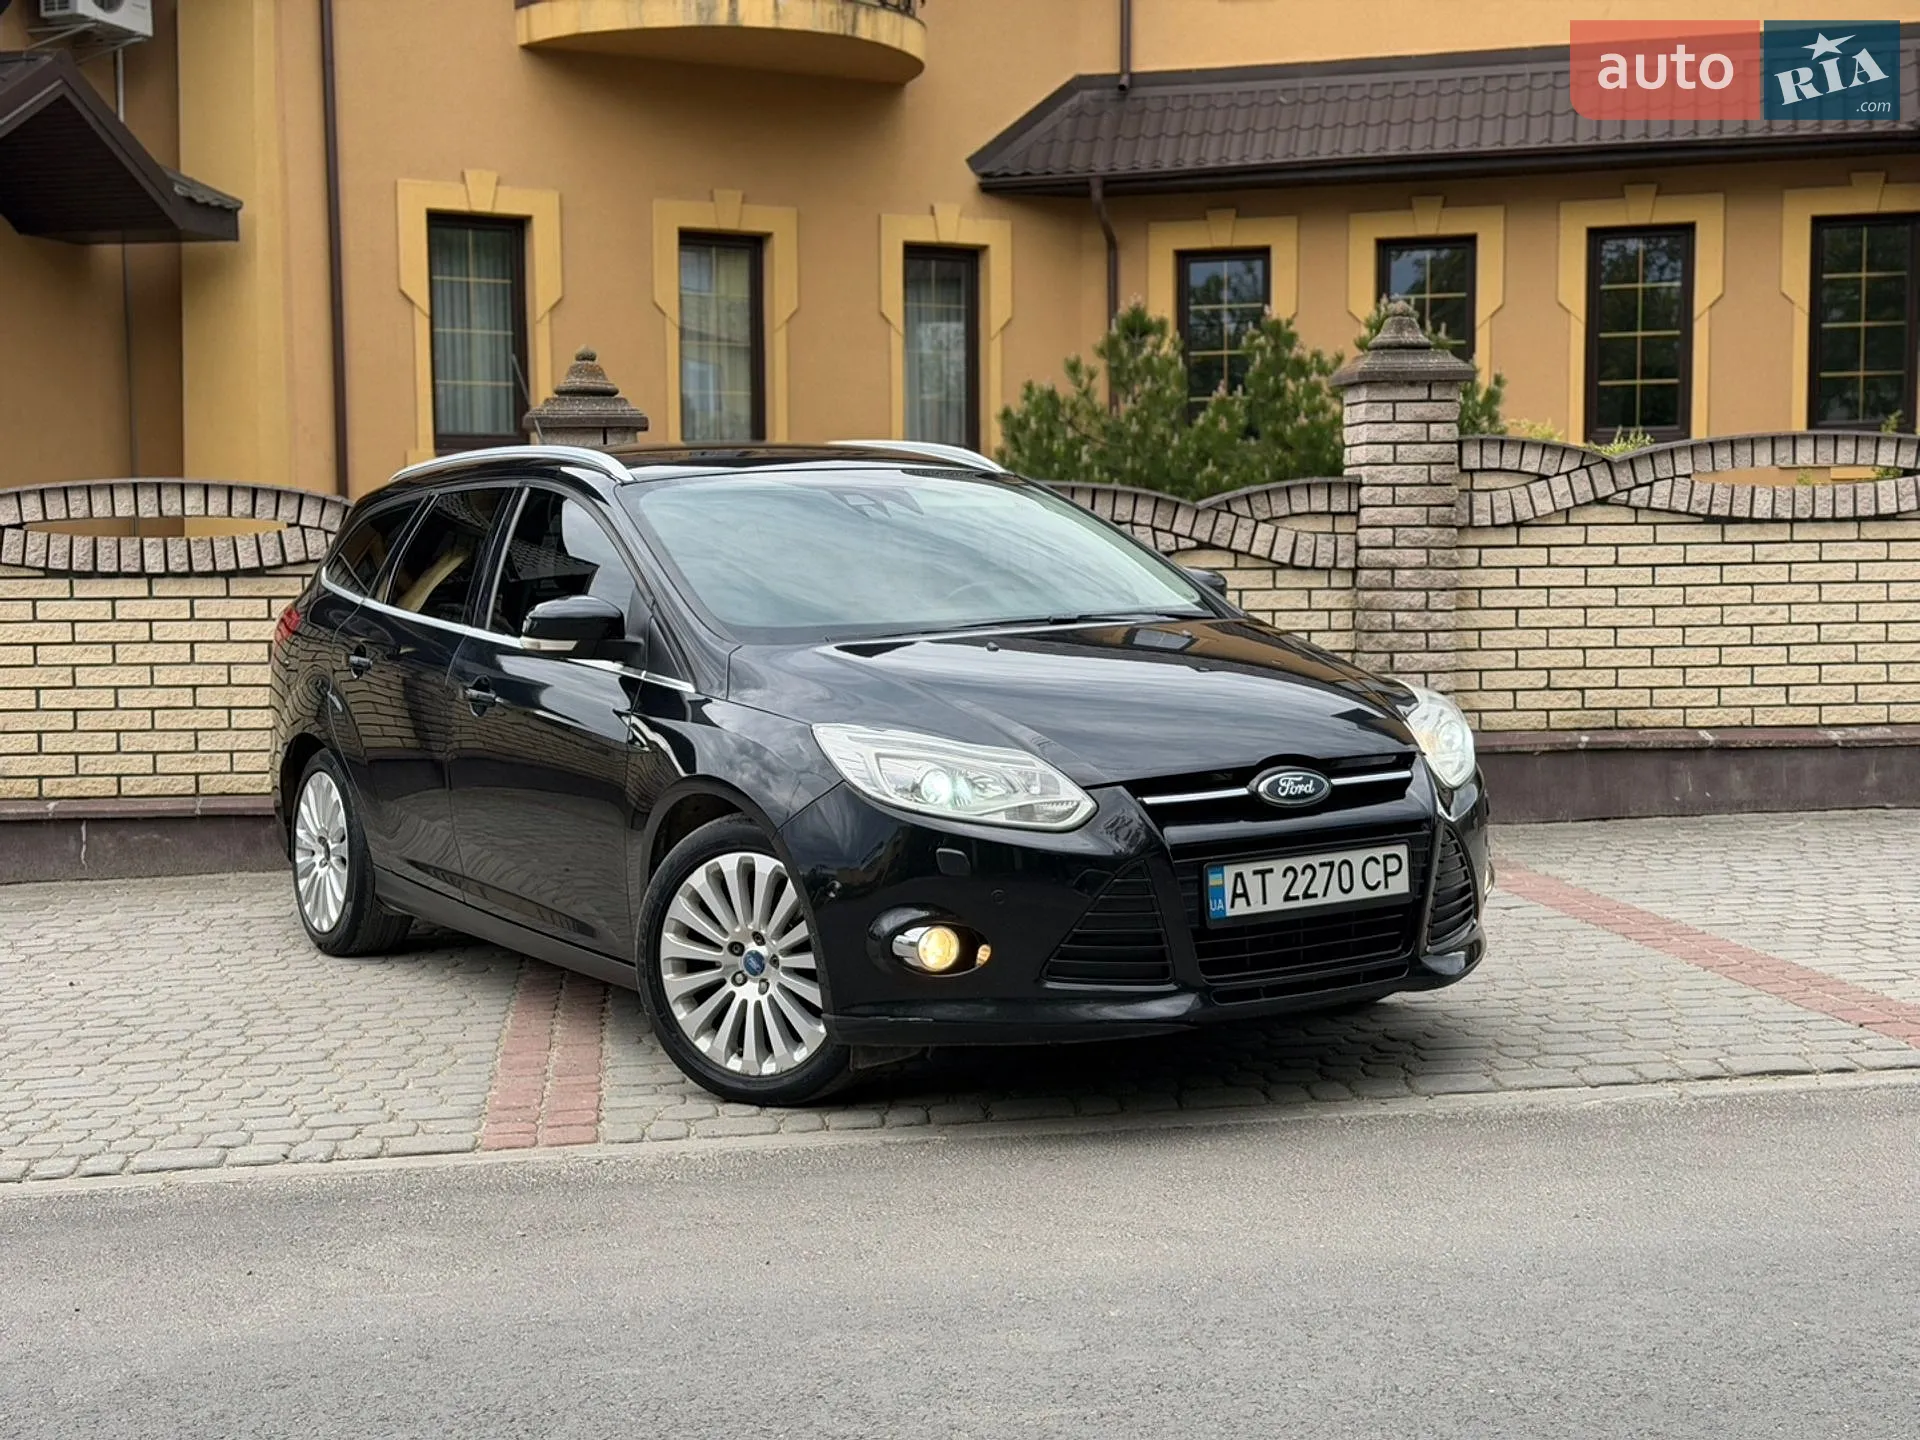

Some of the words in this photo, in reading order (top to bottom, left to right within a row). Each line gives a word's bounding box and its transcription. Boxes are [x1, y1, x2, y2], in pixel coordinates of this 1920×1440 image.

[1278, 776, 1315, 796] Ford
[1229, 868, 1274, 909] AT
[1281, 859, 1355, 903] 2270
[1361, 853, 1403, 892] CP
[1209, 898, 1225, 912] UA
